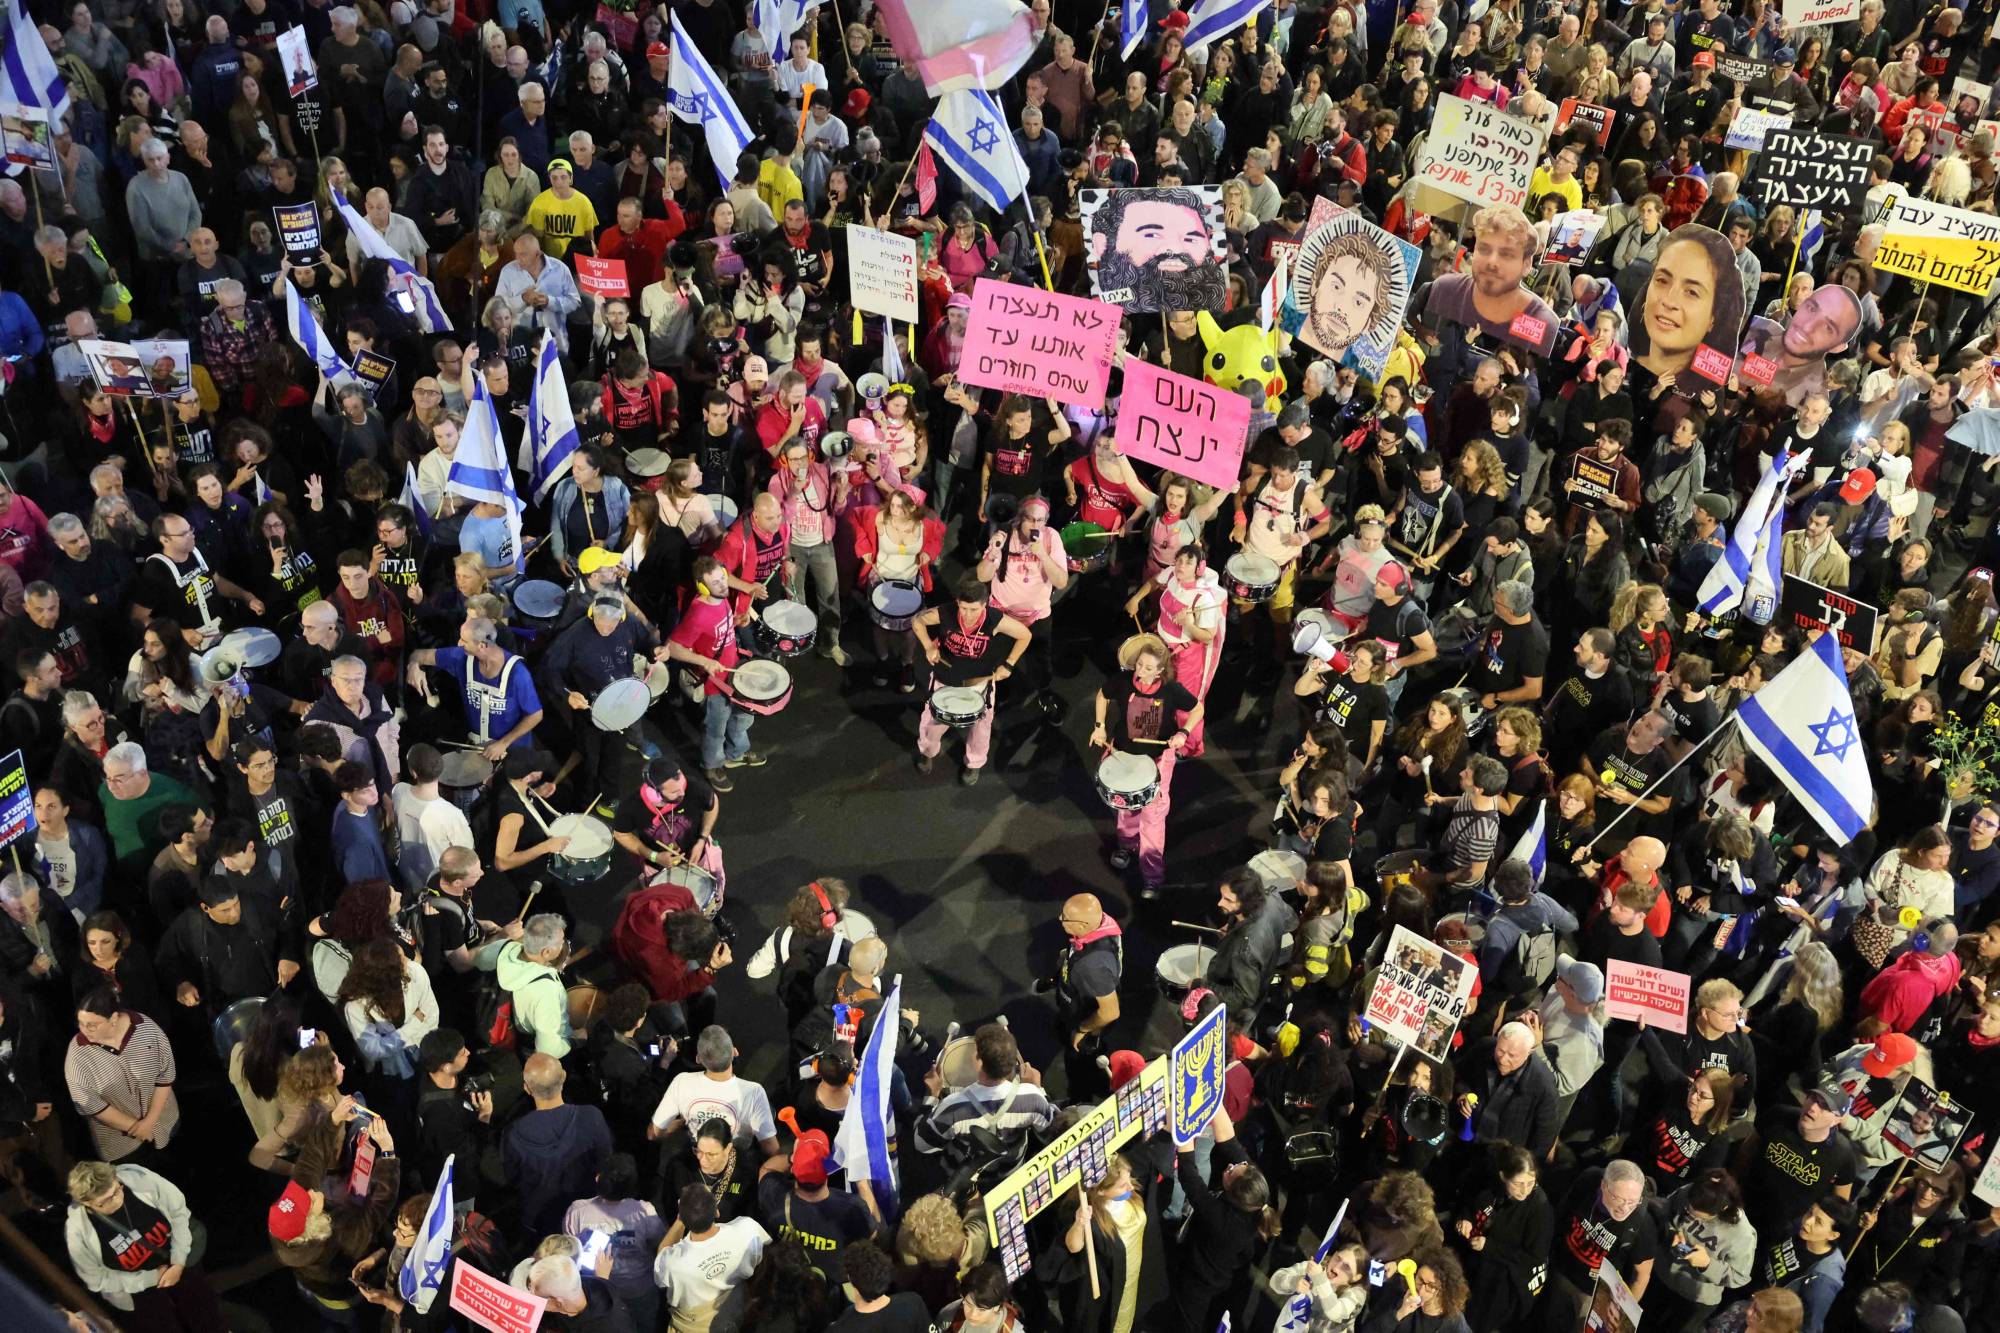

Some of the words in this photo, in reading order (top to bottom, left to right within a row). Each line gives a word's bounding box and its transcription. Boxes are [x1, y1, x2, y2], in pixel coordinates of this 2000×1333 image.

[1725, 58, 1751, 70] שלום
[1752, 63, 1767, 74] רק
[1463, 104, 1492, 127] עוד
[1576, 105, 1606, 121] מדינה
[1500, 120, 1534, 146] כמה
[1510, 168, 1527, 188] עד
[1767, 156, 1869, 184] המדינה
[1477, 174, 1526, 206] להציל
[545, 214, 576, 234] NOW
[1895, 204, 1936, 226] עבר
[284, 228, 318, 242] מסרבים
[286, 238, 319, 251] למלחמה
[587, 259, 608, 269] עסקה
[1973, 245, 2000, 266] על
[593, 269, 603, 277] או
[988, 293, 1060, 322] תעצרו
[1072, 310, 1104, 330] לא
[986, 326, 1020, 346] עד
[1031, 335, 1086, 361] אותנו
[1707, 349, 1731, 366] עדיין
[978, 355, 1038, 382] חוזרים
[1755, 357, 1777, 371] עדיין
[1047, 371, 1089, 394] שהם
[1156, 377, 1216, 422] העם
[1135, 415, 1218, 462] ינצח
[1825, 592, 1857, 616] קודם
[1610, 974, 1655, 990] דורשות
[1658, 983, 1685, 998] נשים
[1394, 990, 1414, 1009] הבן
[1413, 999, 1428, 1016] על
[1427, 989, 1450, 1011] הבן
[1449, 997, 1464, 1018] על
[1650, 996, 1681, 1011] עסקה
[1025, 1111, 1105, 1178] הממשלה
[1769, 1143, 1821, 1182] STAM
[465, 1276, 513, 1310] שהפקיר
[459, 1288, 500, 1321] להחזיר
[515, 1304, 530, 1319] מי
